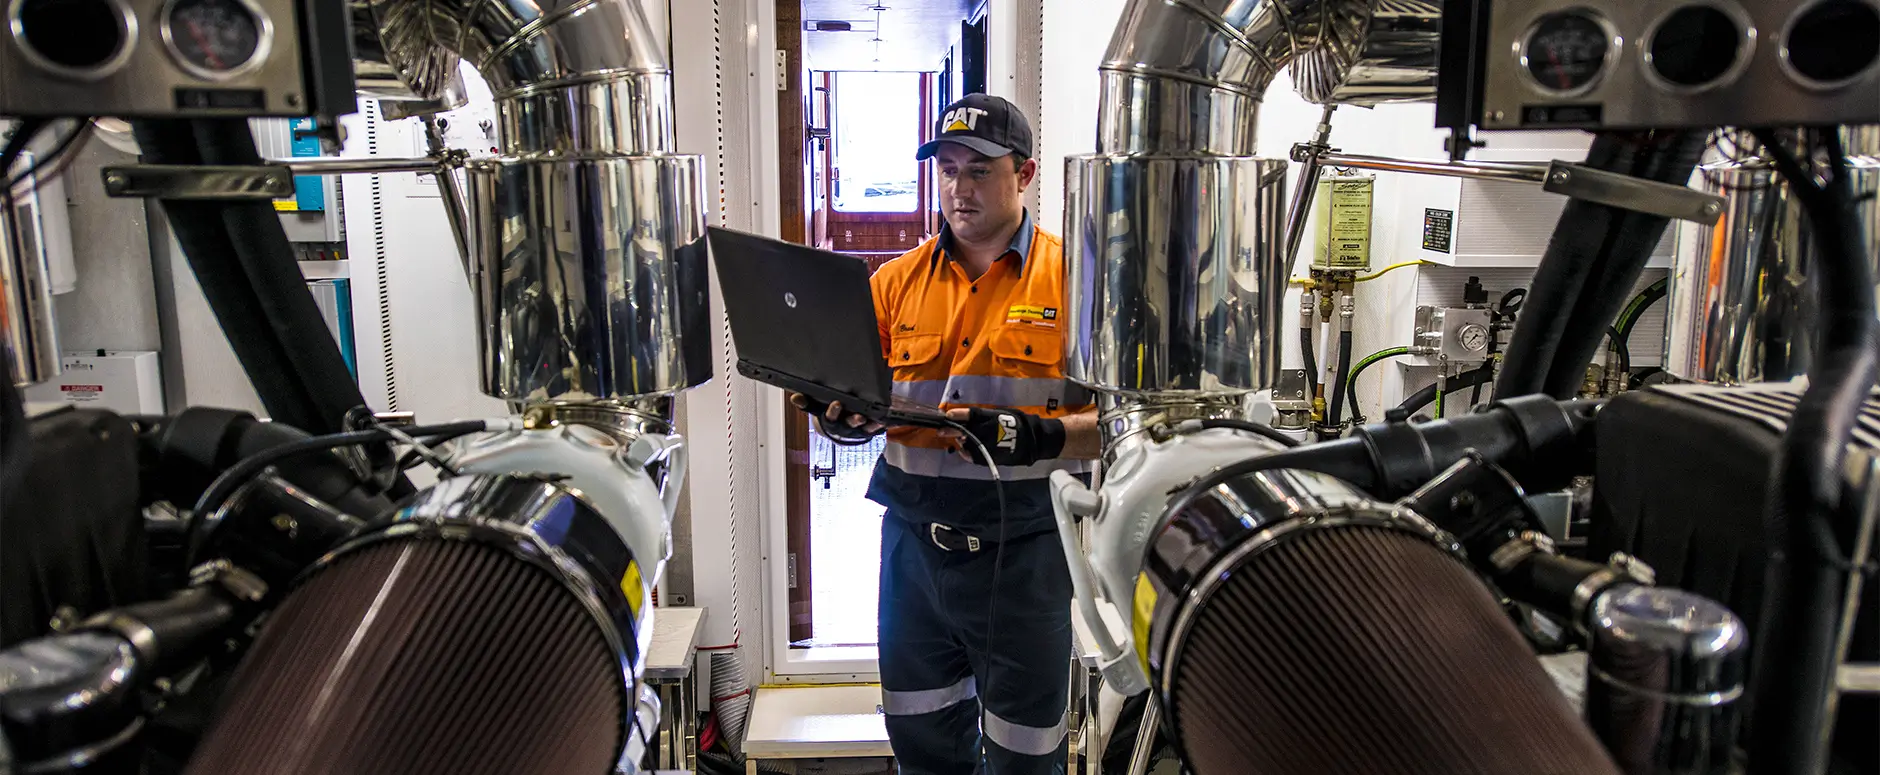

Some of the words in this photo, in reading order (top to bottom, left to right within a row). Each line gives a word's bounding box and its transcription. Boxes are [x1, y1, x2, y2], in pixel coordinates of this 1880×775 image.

[941, 107, 983, 133] CAT
[1044, 309, 1055, 317] CAT
[997, 414, 1017, 450] CAT
